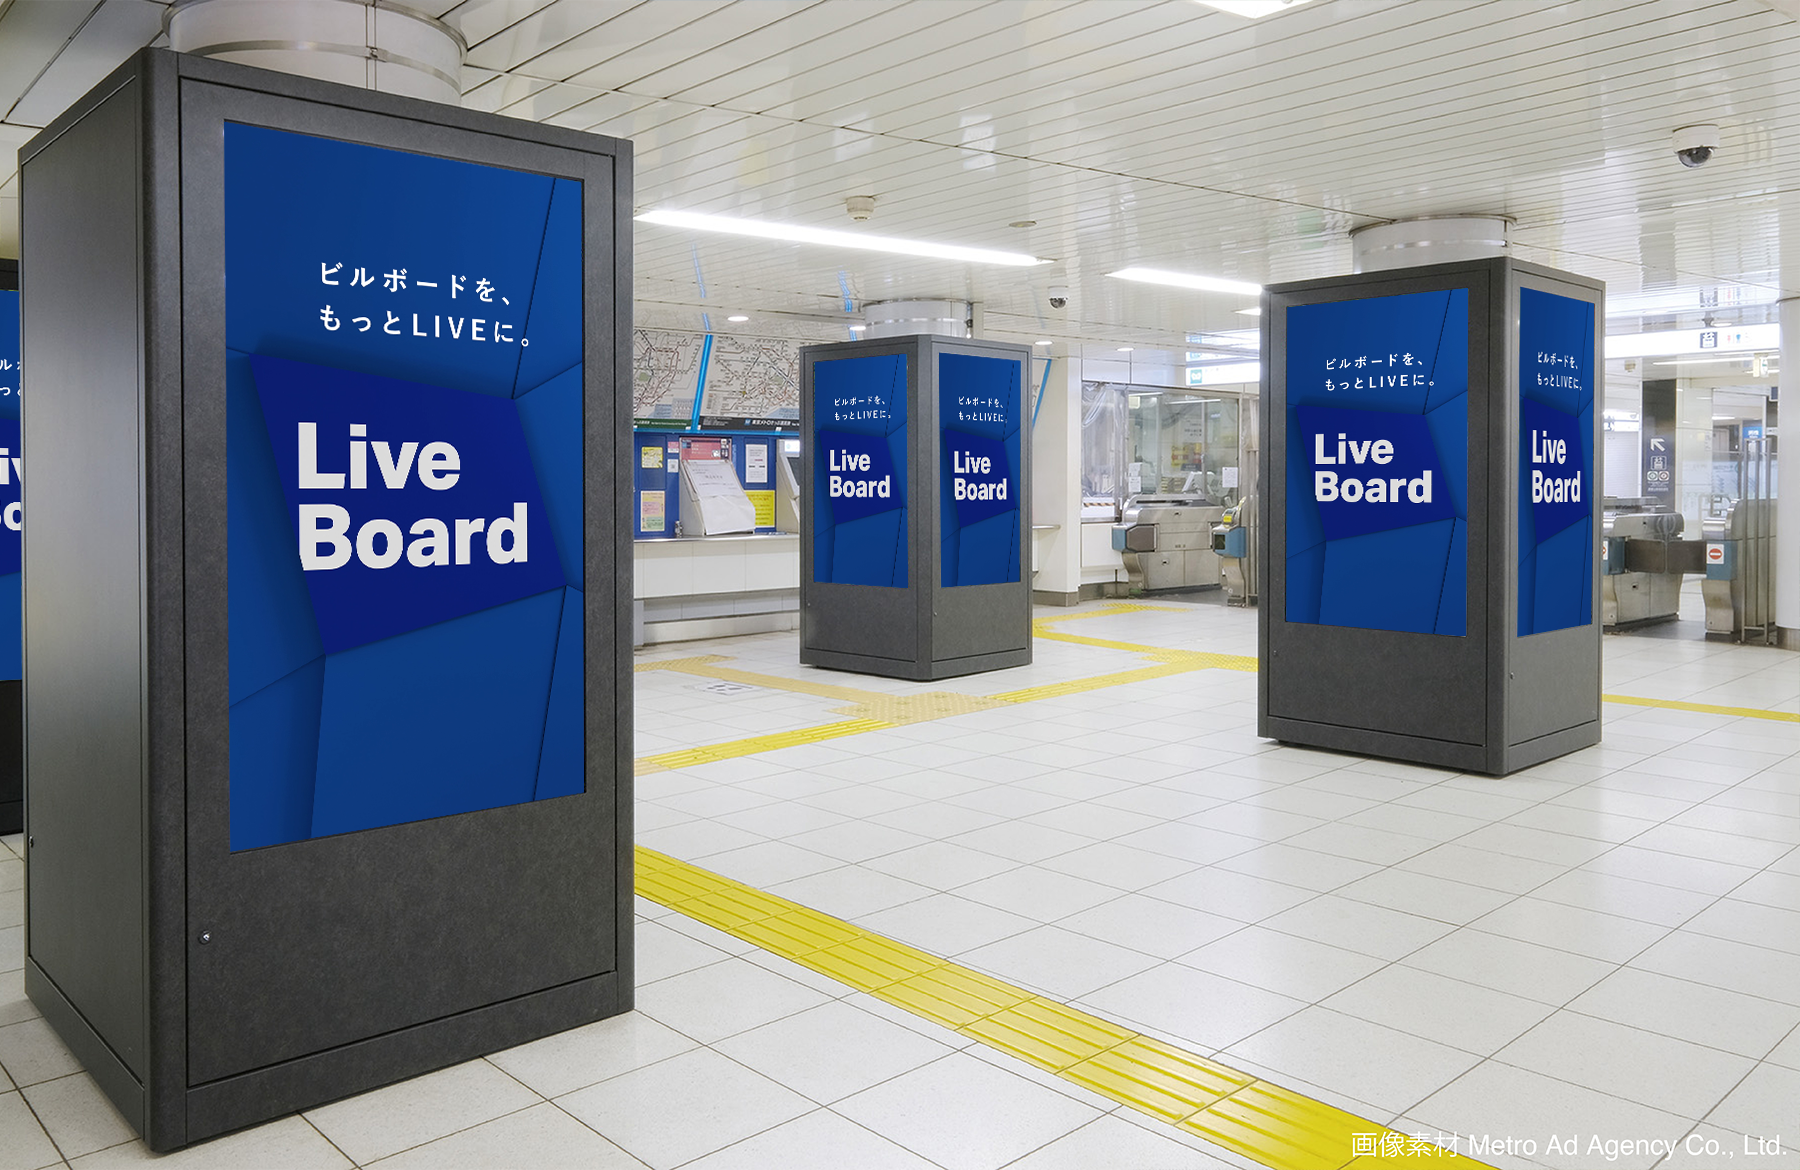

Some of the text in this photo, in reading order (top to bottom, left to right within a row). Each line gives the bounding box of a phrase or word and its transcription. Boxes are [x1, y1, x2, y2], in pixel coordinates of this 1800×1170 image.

[321, 261, 511, 306] ビルボードを、
[319, 304, 529, 347] もっとLIVEに。
[1326, 352, 1423, 370] ビルボードを、
[1537, 351, 1579, 370] ビルボードを、
[1325, 374, 1435, 391] もっとLIVEに。
[1537, 373, 1583, 391] もっとLIVEに。
[834, 410, 891, 421] もっとLIVEに。
[298, 421, 461, 491] Live
[1315, 433, 1394, 465] Live
[1532, 429, 1567, 465] Live
[830, 450, 871, 472] Live
[954, 451, 992, 475] Live
[830, 475, 891, 498] Board
[954, 478, 1008, 501] Board
[1315, 470, 1433, 504] Board
[1532, 470, 1581, 504] Board
[298, 502, 528, 571] Board
